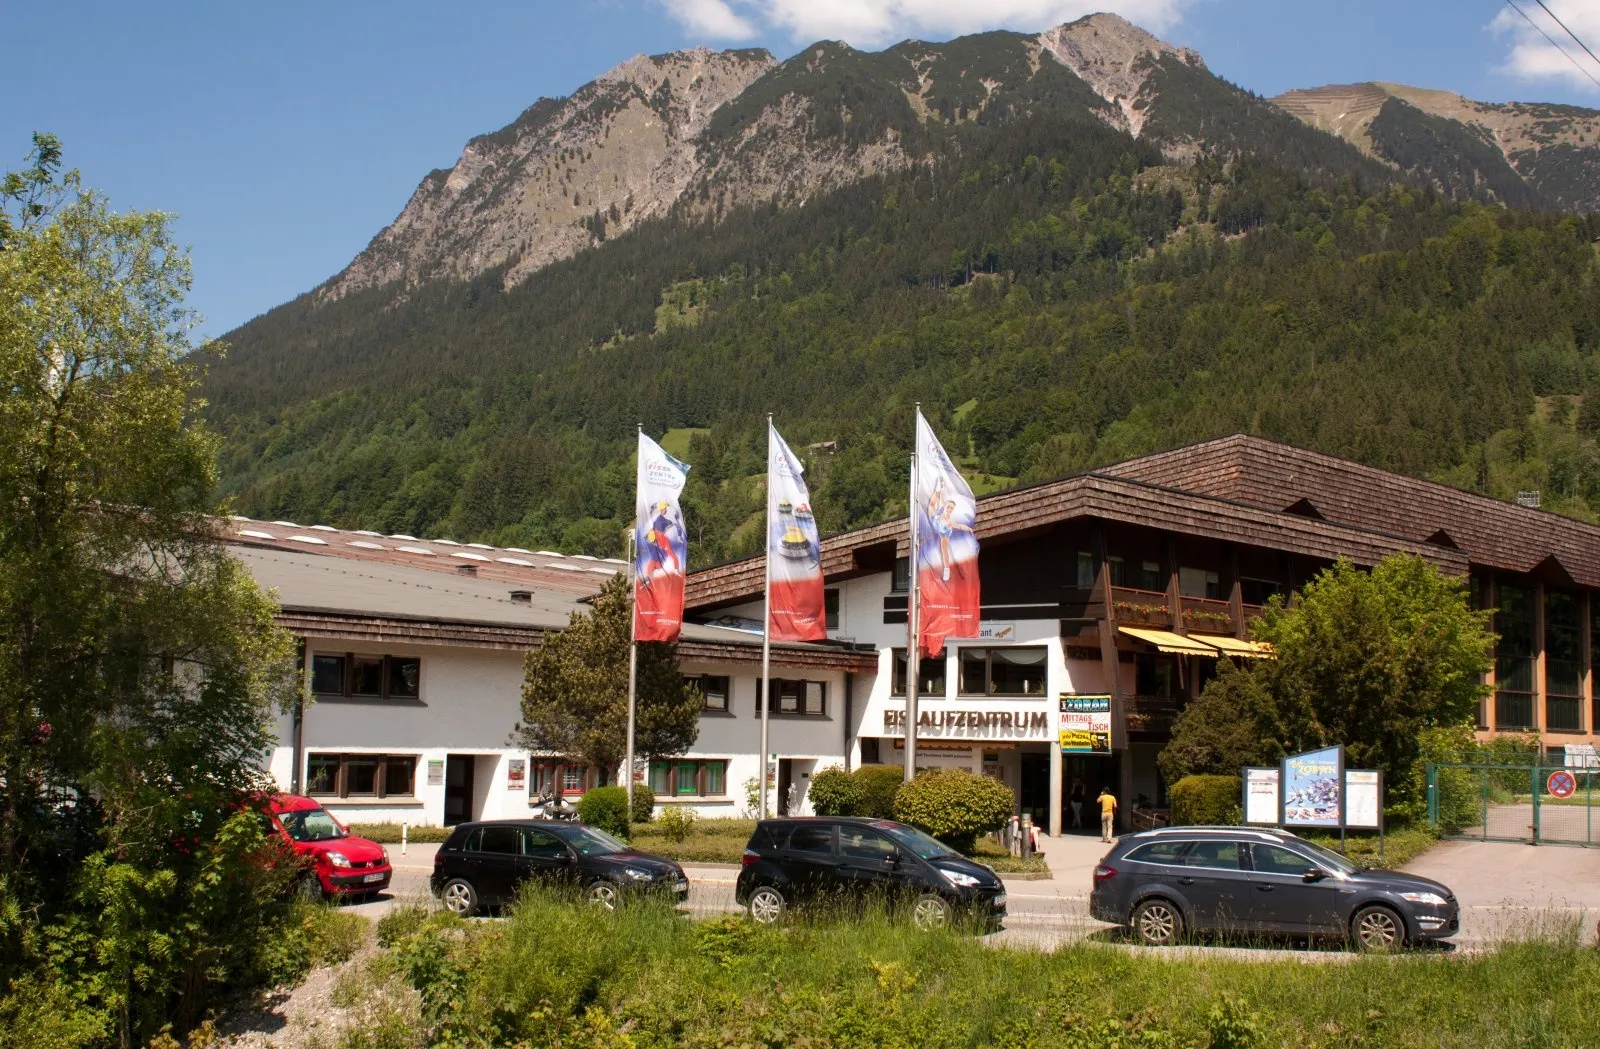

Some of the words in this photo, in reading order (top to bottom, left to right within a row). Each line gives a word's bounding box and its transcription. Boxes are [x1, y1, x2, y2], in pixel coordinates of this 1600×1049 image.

[883, 709, 1048, 729] EISAUFZENTRUM
[1061, 714, 1093, 723] MITTAGS
[1088, 722, 1109, 731] TISCH
